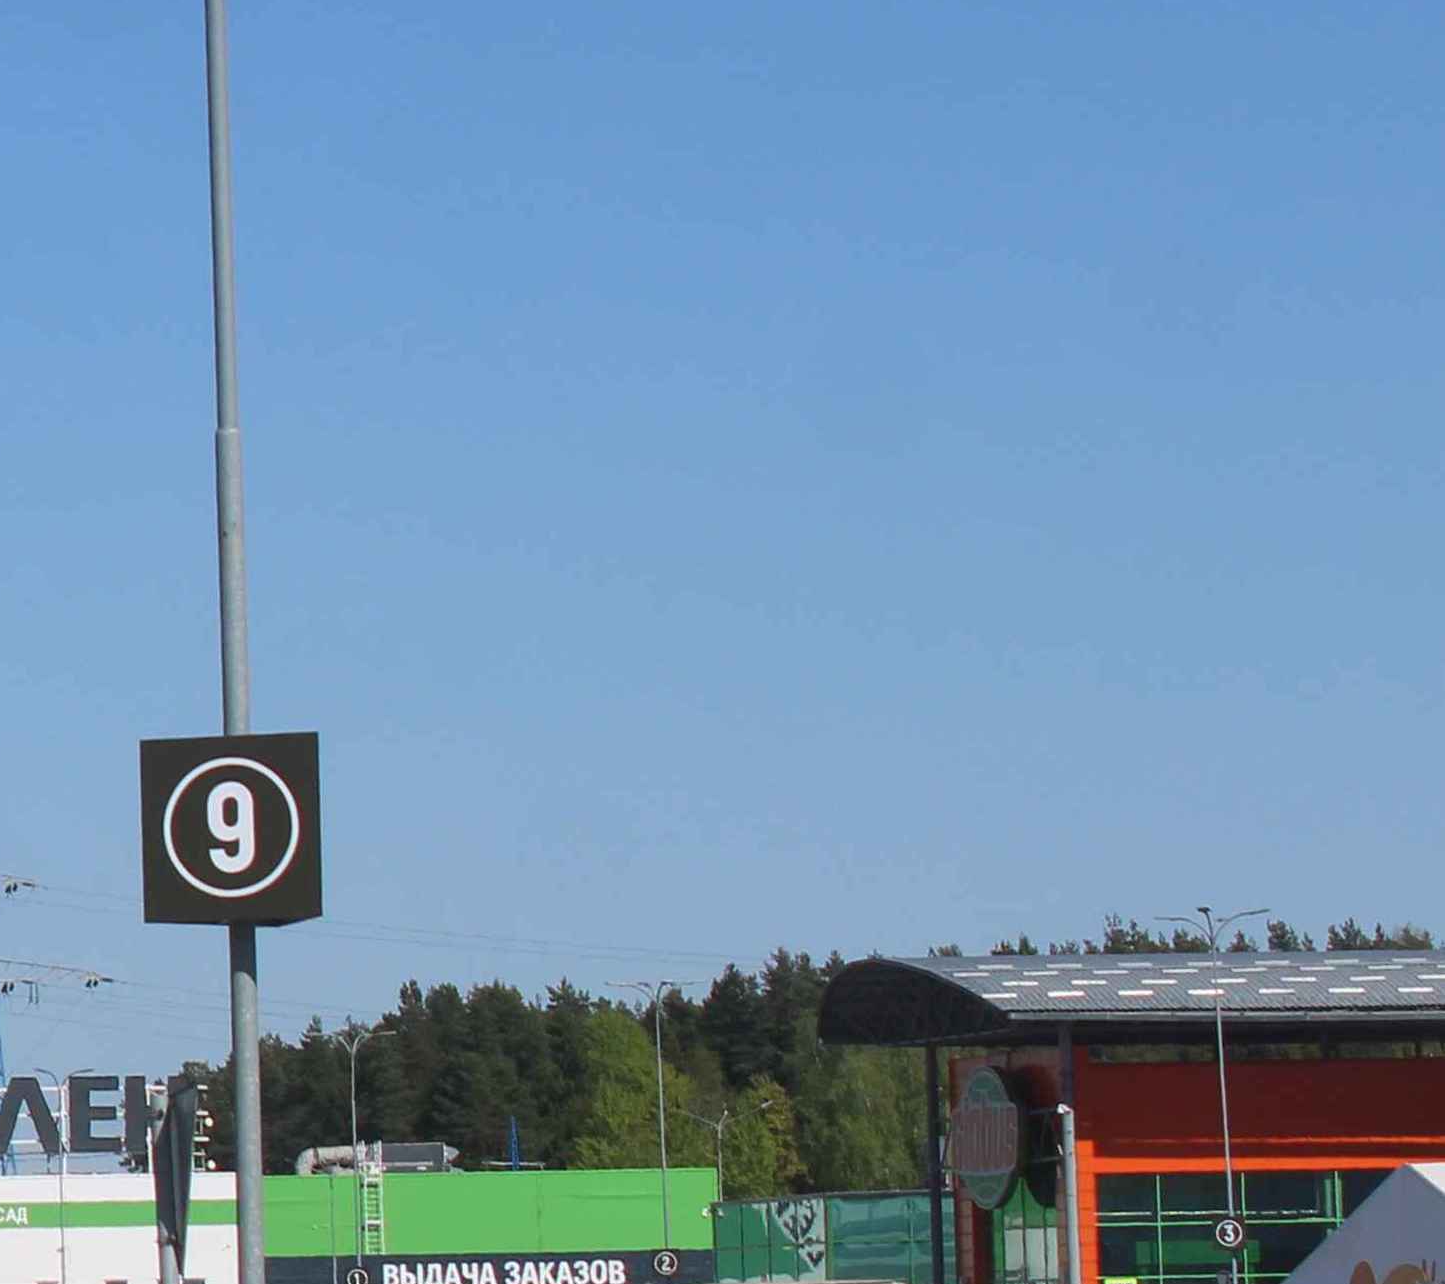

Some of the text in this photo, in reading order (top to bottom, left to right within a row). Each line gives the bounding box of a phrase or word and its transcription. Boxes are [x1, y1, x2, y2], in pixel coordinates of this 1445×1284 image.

[206, 780, 257, 875] 9
[1224, 1223, 1236, 1244] 3
[661, 1256, 671, 1272] 2
